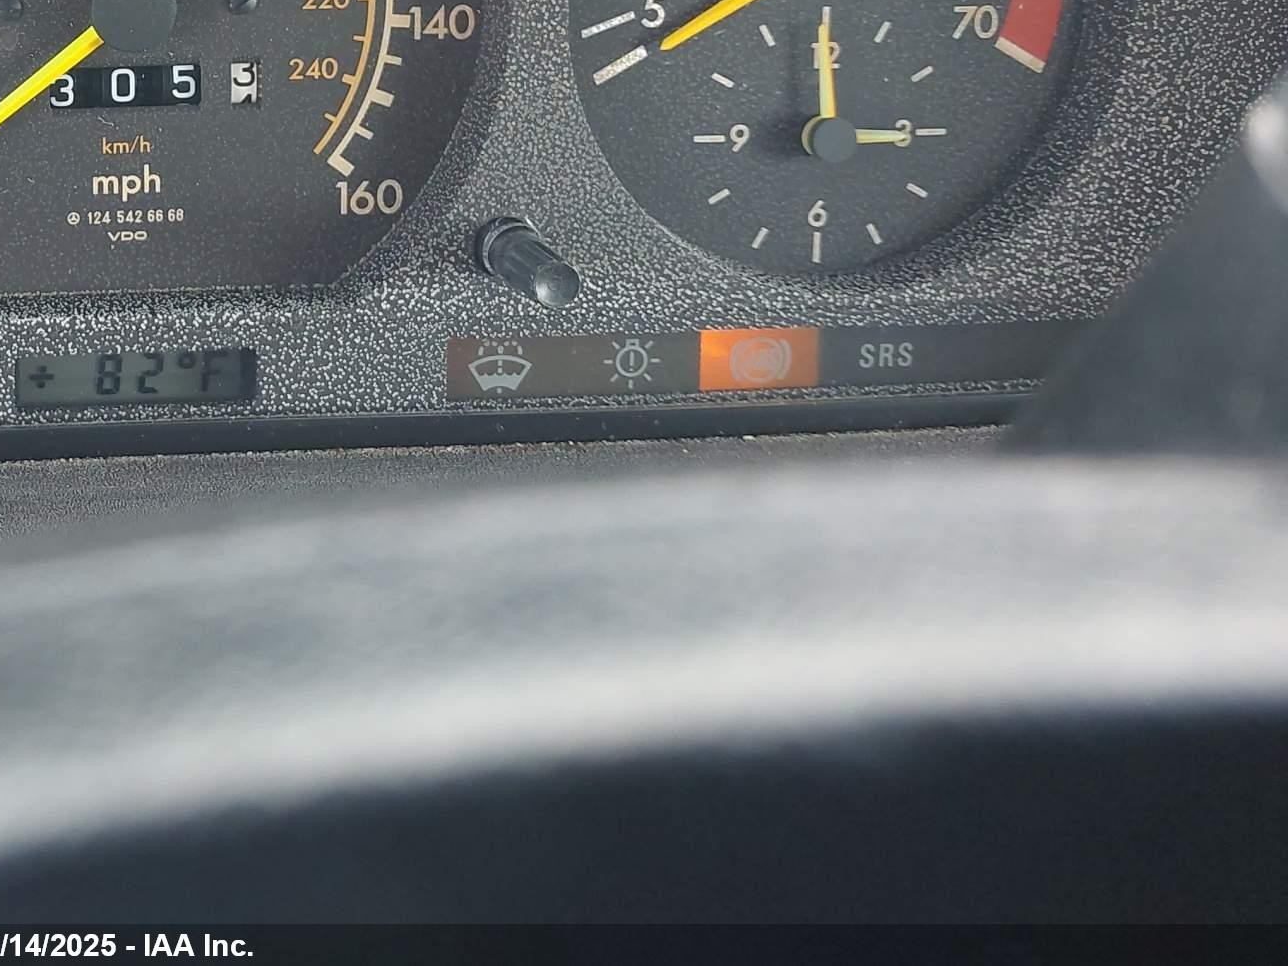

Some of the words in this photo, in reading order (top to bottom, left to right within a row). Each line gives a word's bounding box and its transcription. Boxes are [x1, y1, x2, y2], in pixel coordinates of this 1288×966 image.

[409, 4, 476, 41] 140
[952, 4, 1000, 40] 70
[288, 57, 339, 81] 240
[102, 135, 152, 155] km/h
[728, 124, 750, 153] 9
[92, 163, 162, 203] mph
[336, 179, 403, 216] 160
[87, 210, 112, 225] 124
[116, 209, 143, 224] 542
[147, 209, 164, 223] 66
[167, 208, 185, 222] 68
[807, 200, 828, 227] 6
[107, 230, 148, 242] VDO
[859, 343, 913, 368] SRS
